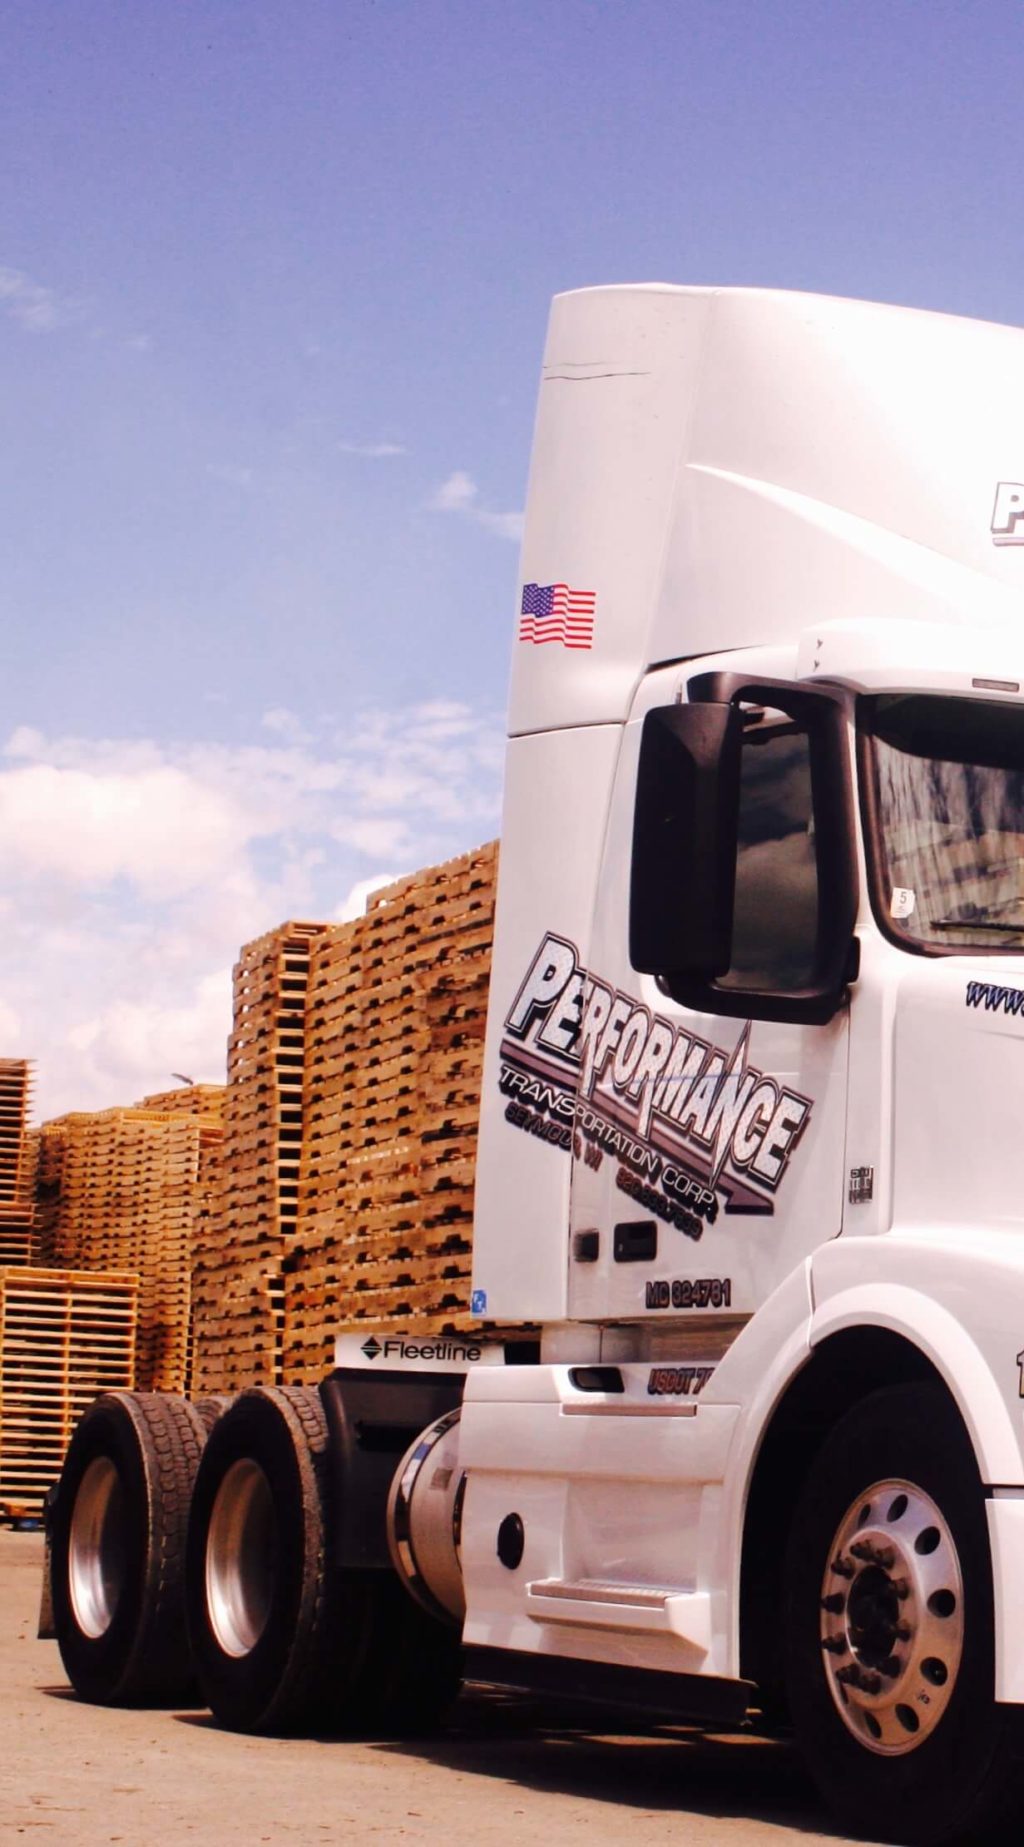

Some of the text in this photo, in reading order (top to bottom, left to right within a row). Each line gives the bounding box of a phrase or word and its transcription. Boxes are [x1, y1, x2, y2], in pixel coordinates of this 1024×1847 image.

[900, 891, 907, 904] 5
[504, 931, 814, 1194] PERFORMANCE
[500, 1066, 717, 1220] TRANSPORTATION CORP.
[384, 1341, 481, 1361] Fleetline
[648, 1367, 696, 1395] USDOT
